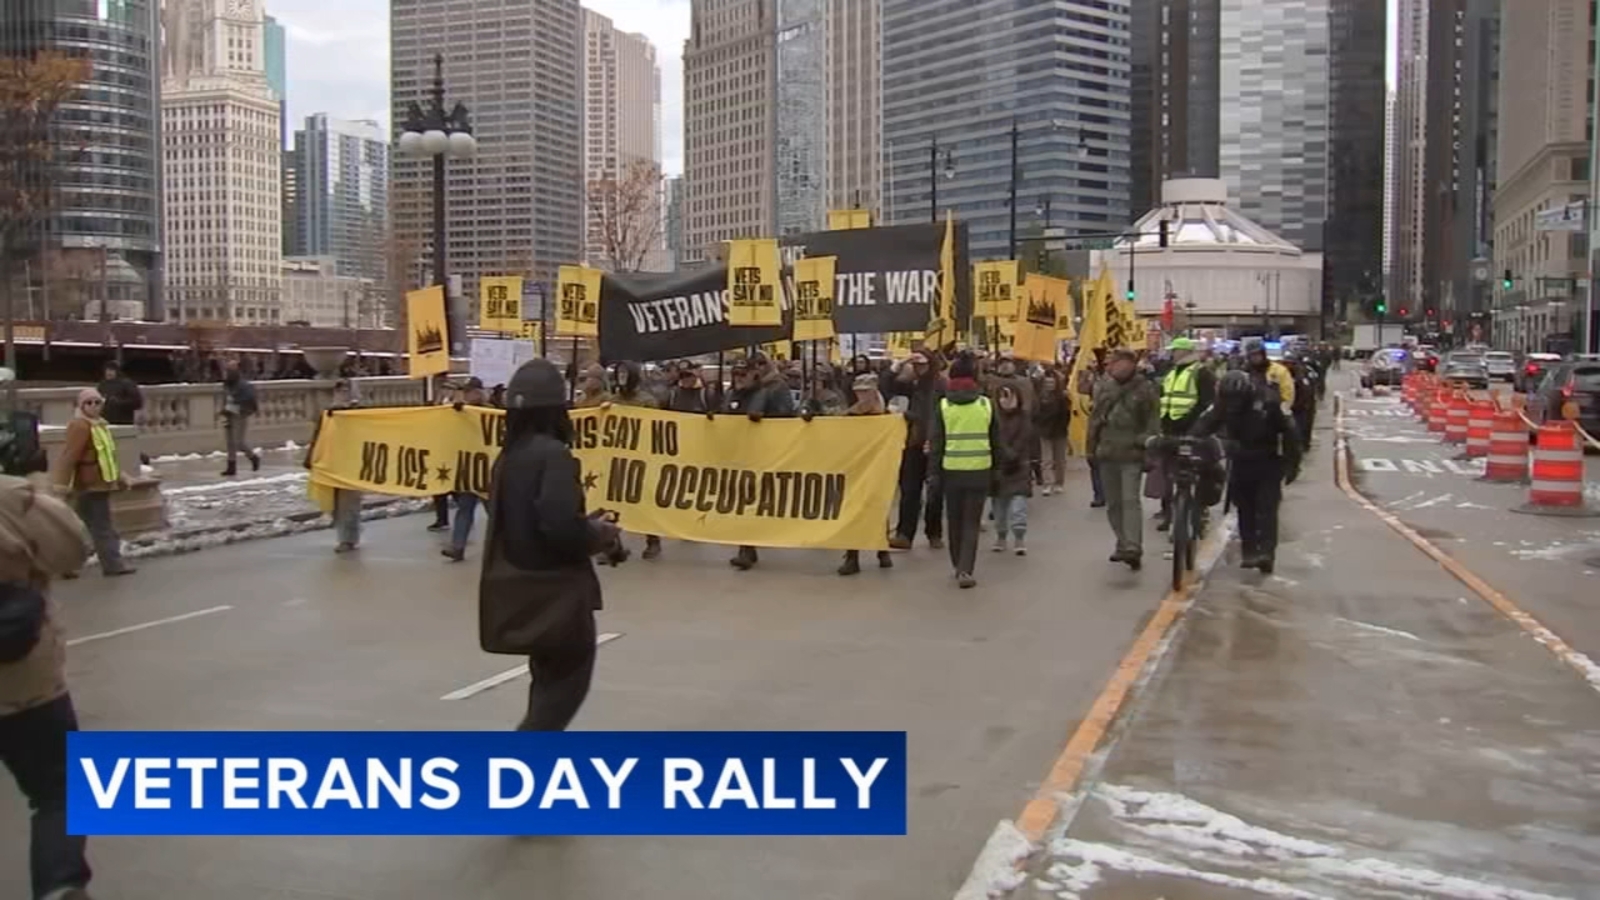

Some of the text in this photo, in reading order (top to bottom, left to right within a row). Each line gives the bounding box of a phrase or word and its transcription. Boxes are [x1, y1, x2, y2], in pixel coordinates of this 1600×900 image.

[734, 267, 760, 284] VETS
[487, 286, 508, 300] VETS
[562, 283, 586, 300] VETS
[734, 285, 773, 301] SAY NO
[797, 280, 819, 297] VETS
[836, 273, 876, 306] THE
[886, 270, 937, 304] WAR
[487, 300, 518, 315] SAY NO
[562, 300, 595, 318] SAY NO
[797, 297, 831, 315] SAY NO
[602, 414, 642, 450] SAY
[651, 419, 679, 456] NO
[360, 441, 388, 485] NO
[396, 445, 430, 490] ICE
[455, 450, 489, 493] NO
[607, 457, 646, 504] NO
[655, 464, 845, 521] OCCUPATION
